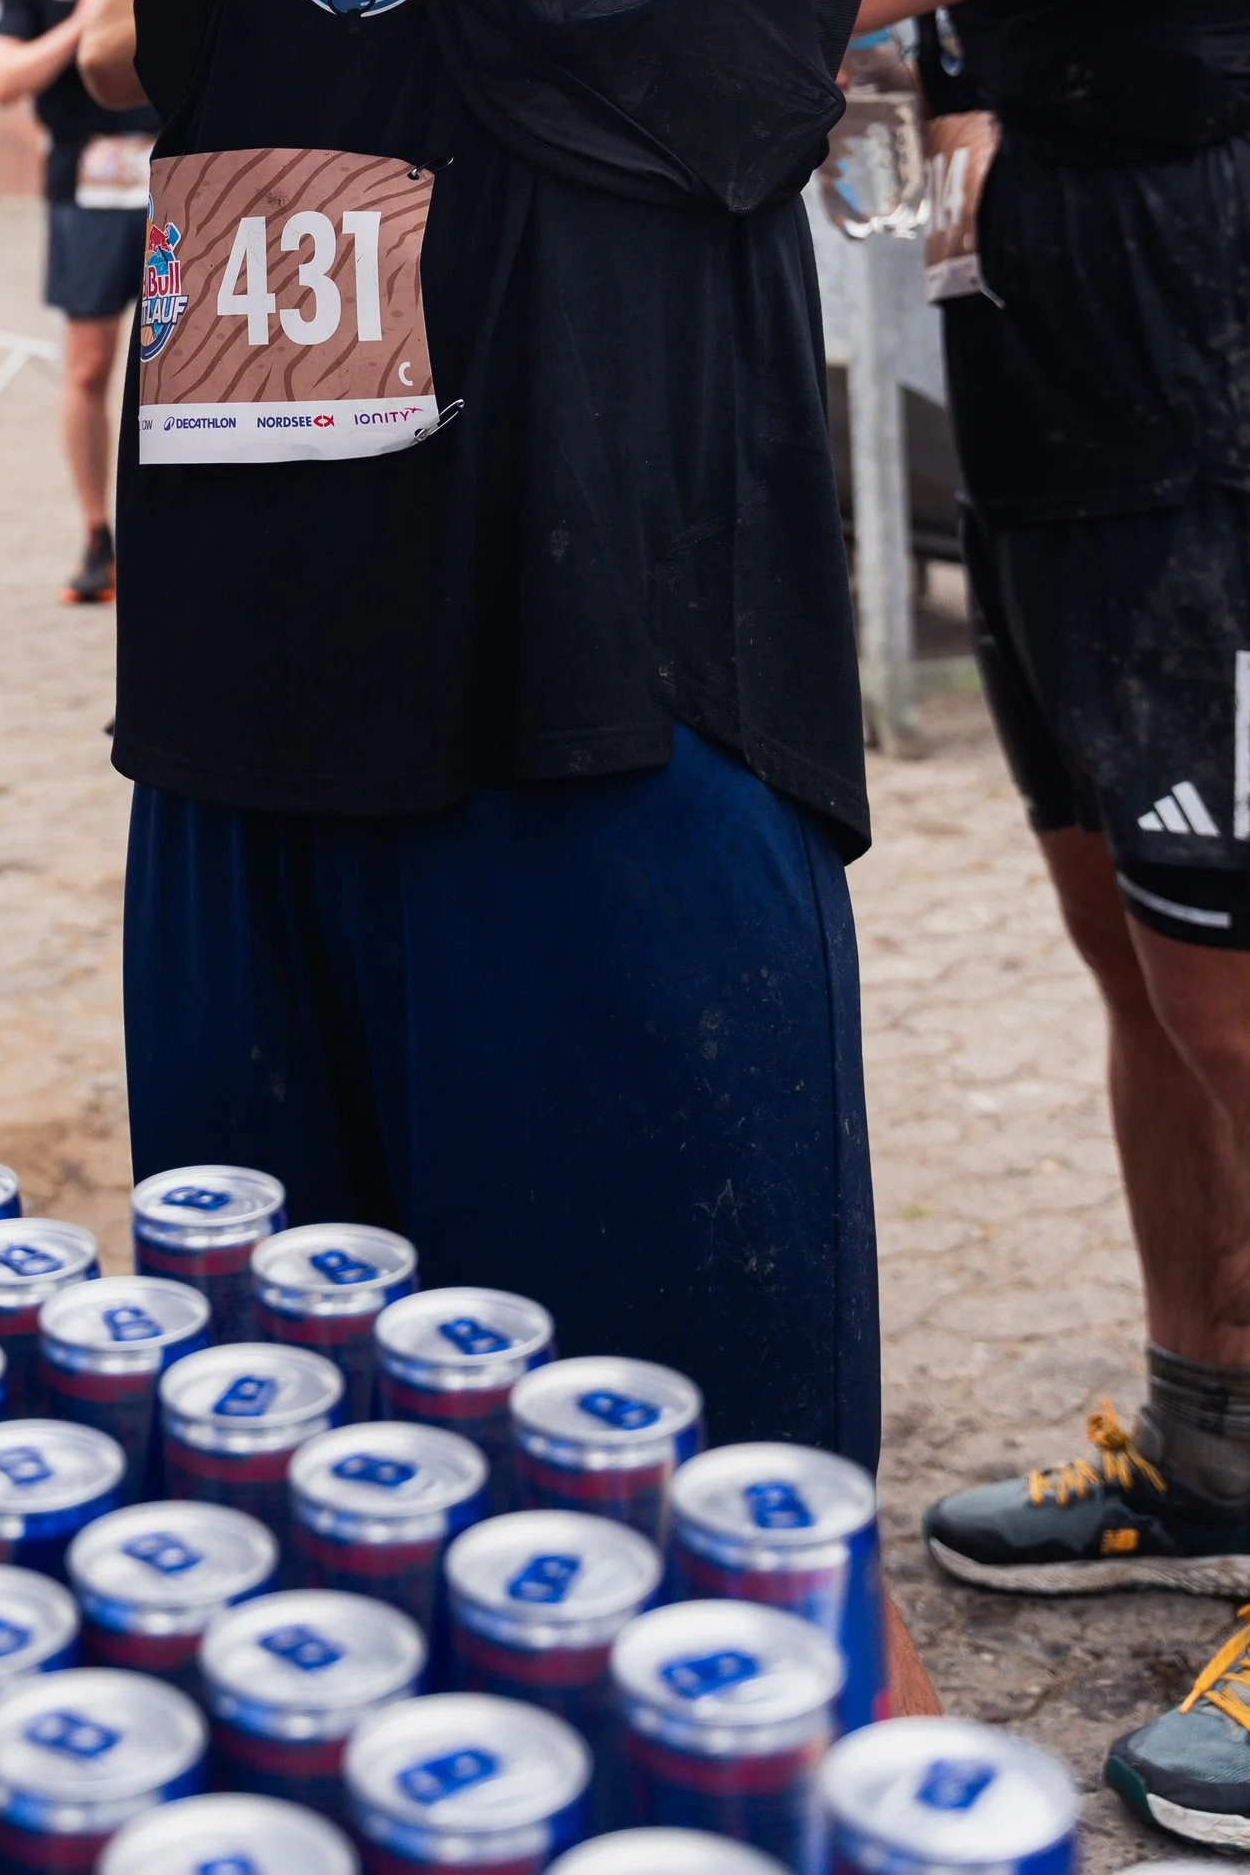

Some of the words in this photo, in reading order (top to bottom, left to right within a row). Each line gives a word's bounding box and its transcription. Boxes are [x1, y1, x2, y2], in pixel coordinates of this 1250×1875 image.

[924, 147, 970, 237] 14
[217, 211, 383, 346] 431
[176, 417, 237, 429] DECATHLON
[257, 416, 312, 428] NORDSEE
[354, 411, 410, 425] IONITY
